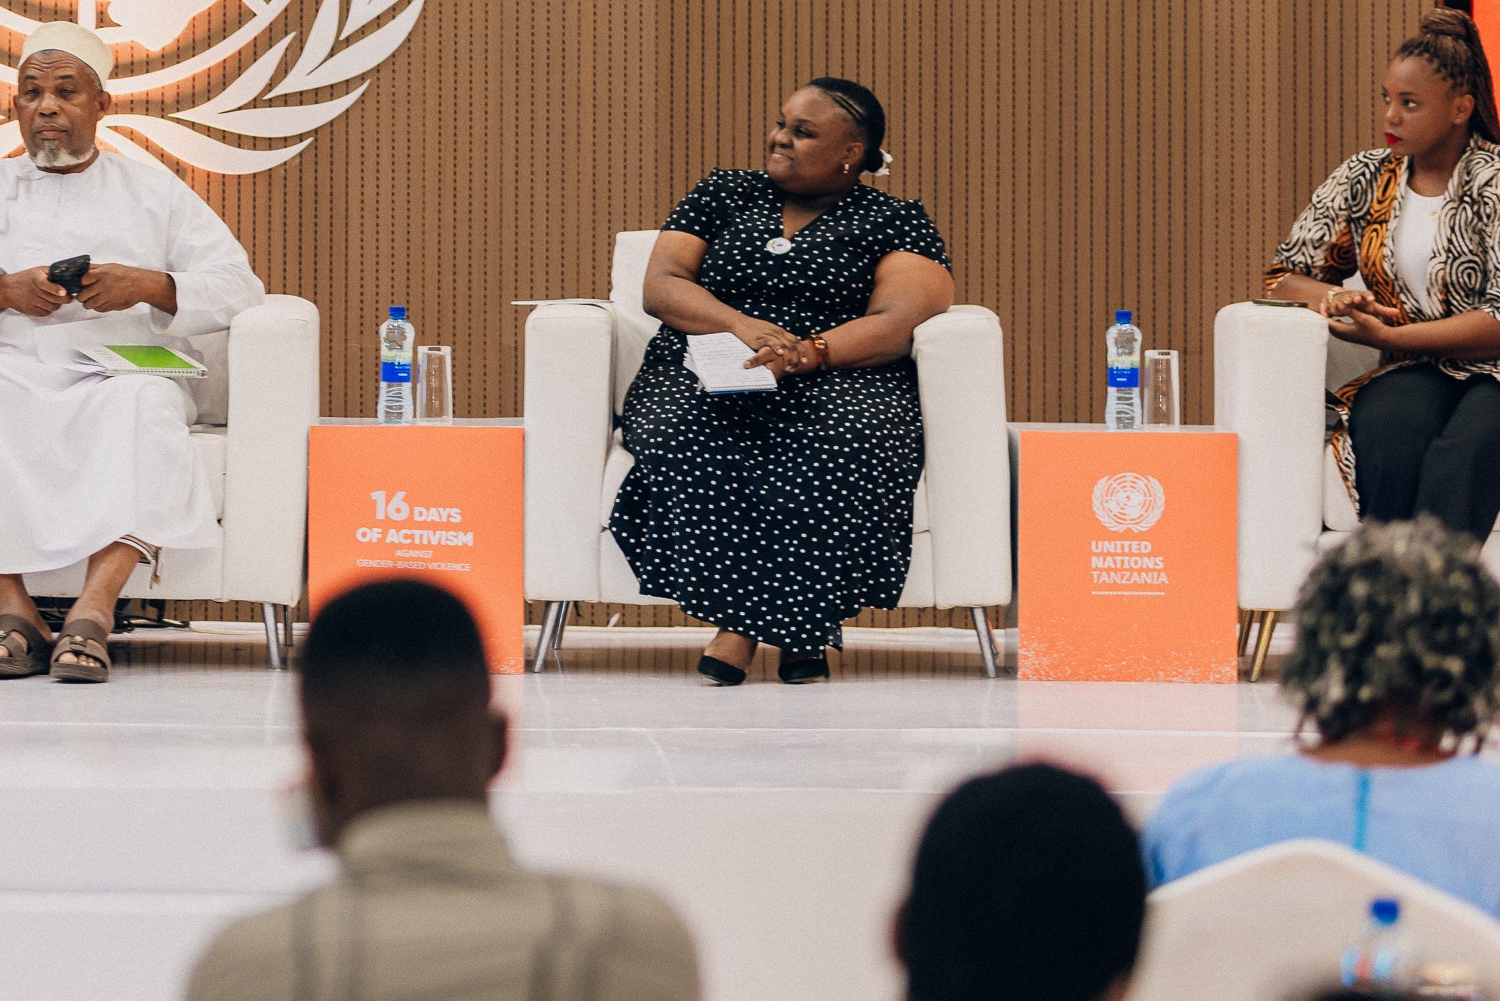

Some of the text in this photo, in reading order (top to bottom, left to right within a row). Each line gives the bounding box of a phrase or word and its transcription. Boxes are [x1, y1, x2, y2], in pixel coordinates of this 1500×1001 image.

[370, 490, 462, 523] 16 DAYS
[355, 527, 474, 547] OF ACTIVISM
[1090, 540, 1152, 553] UNITED
[1090, 556, 1165, 569] NATIONS
[1090, 571, 1170, 584] TANZANIA
